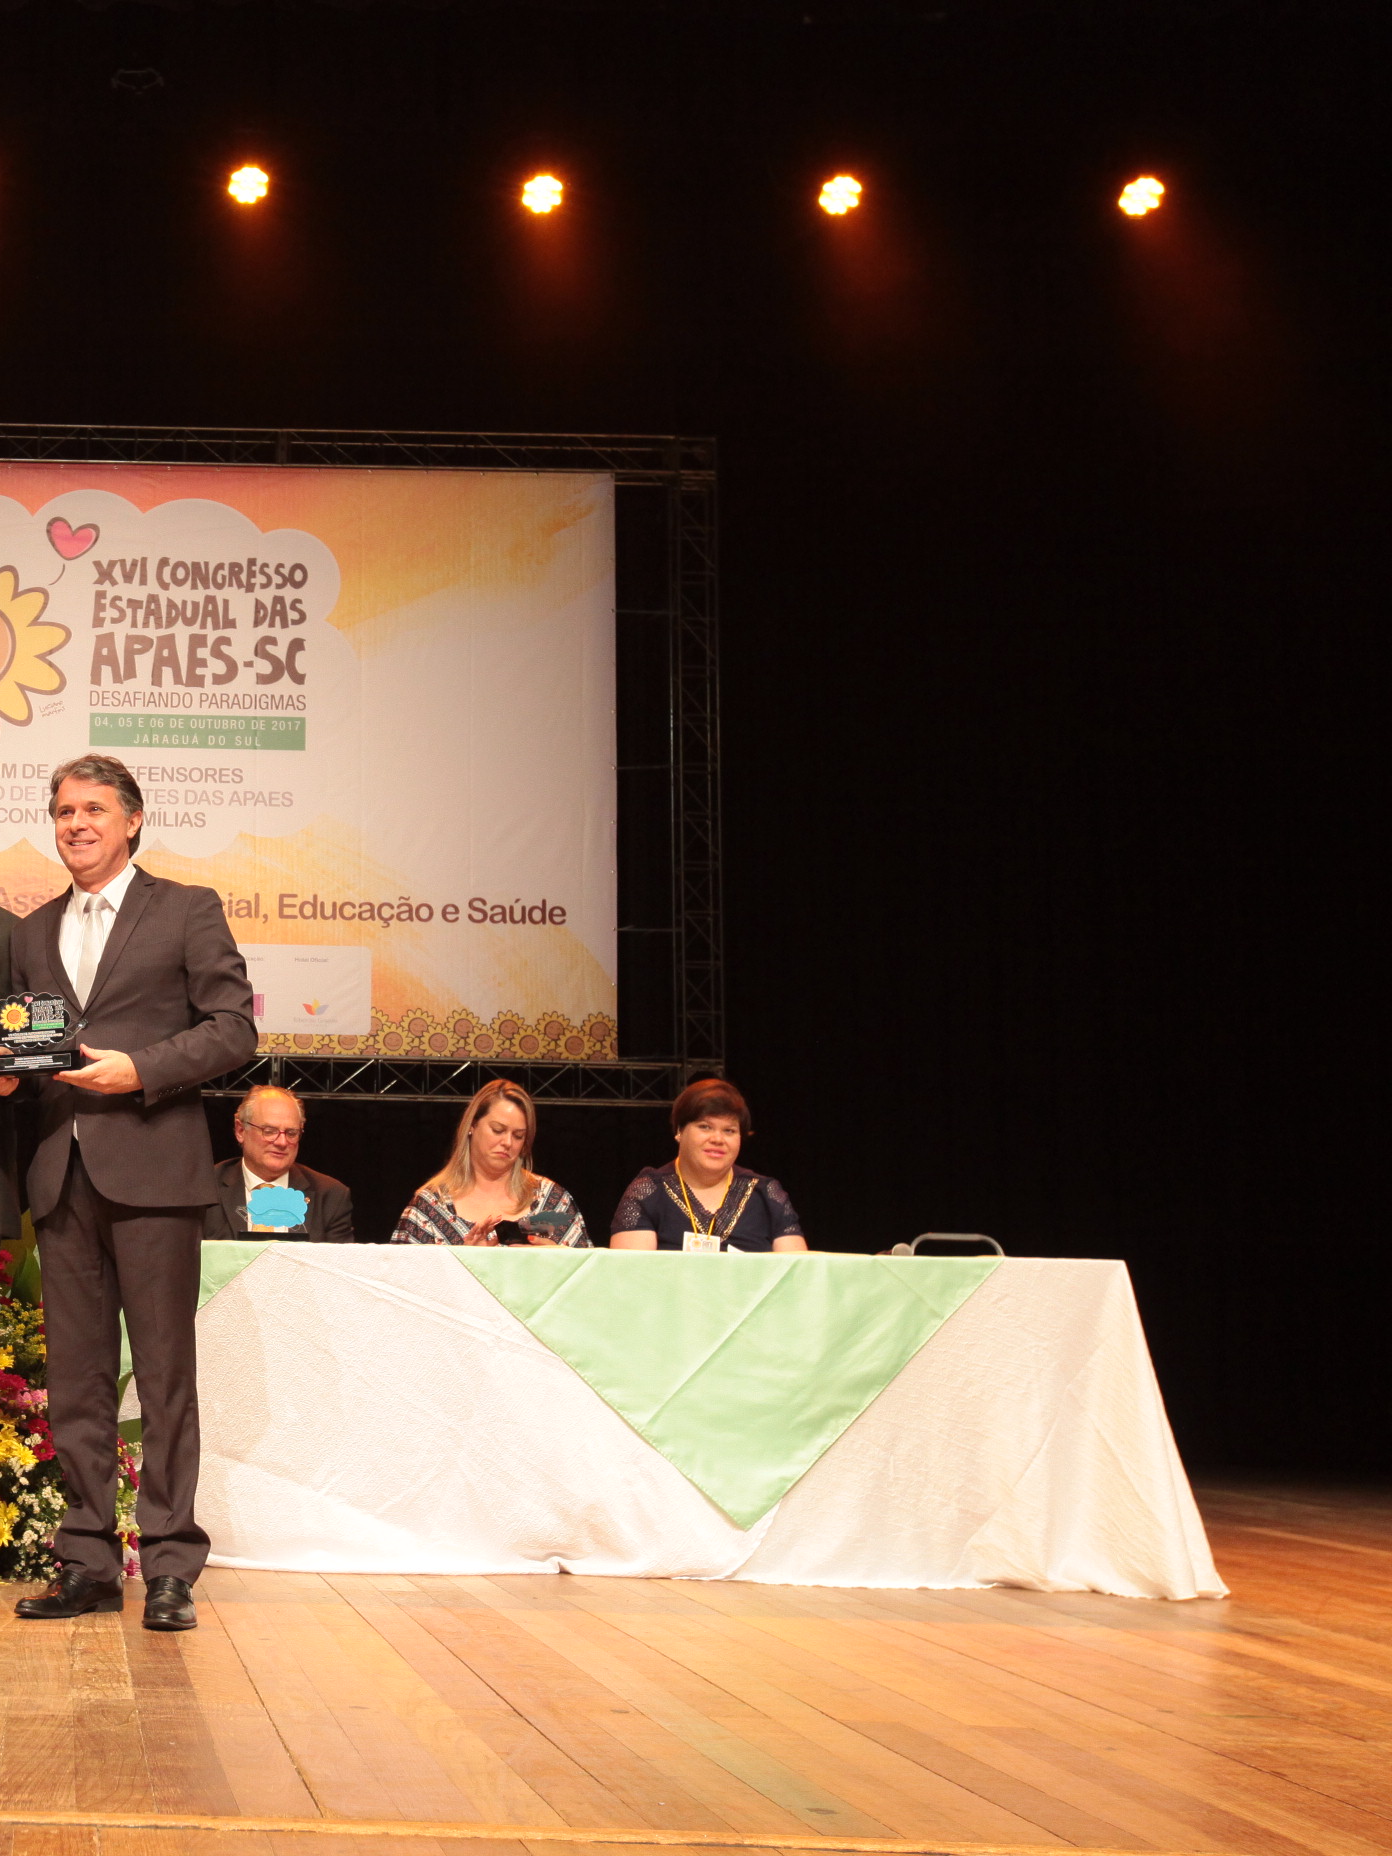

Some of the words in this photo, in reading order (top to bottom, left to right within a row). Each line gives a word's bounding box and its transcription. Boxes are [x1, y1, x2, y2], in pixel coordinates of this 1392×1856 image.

[92, 557, 148, 587] XVI
[156, 557, 309, 593] CONGRESSO
[92, 590, 237, 631] ESTADUAL
[253, 595, 307, 629] DAS
[90, 632, 307, 688] APAES-SC
[89, 690, 194, 709] DESAFIANDO
[199, 692, 307, 711] PARADIGMAS
[94, 716, 113, 729] 04,
[118, 717, 133, 728] 05
[138, 717, 145, 728] E
[149, 718, 164, 729] 06
[170, 718, 185, 729] DE
[190, 718, 246, 730] OUTUBRO
[251, 719, 267, 731] DE
[271, 720, 302, 731] 2017
[133, 732, 199, 745] JARAGUÁ
[208, 735, 227, 746] DO
[235, 736, 262, 747] SUL
[22, 763, 49, 780] DE
[10, 785, 37, 802] DE
[184, 789, 224, 807] DAS
[228, 790, 294, 808] APAES
[277, 893, 434, 928] Educação
[441, 901, 460, 923] e
[467, 896, 568, 926] Saúde
